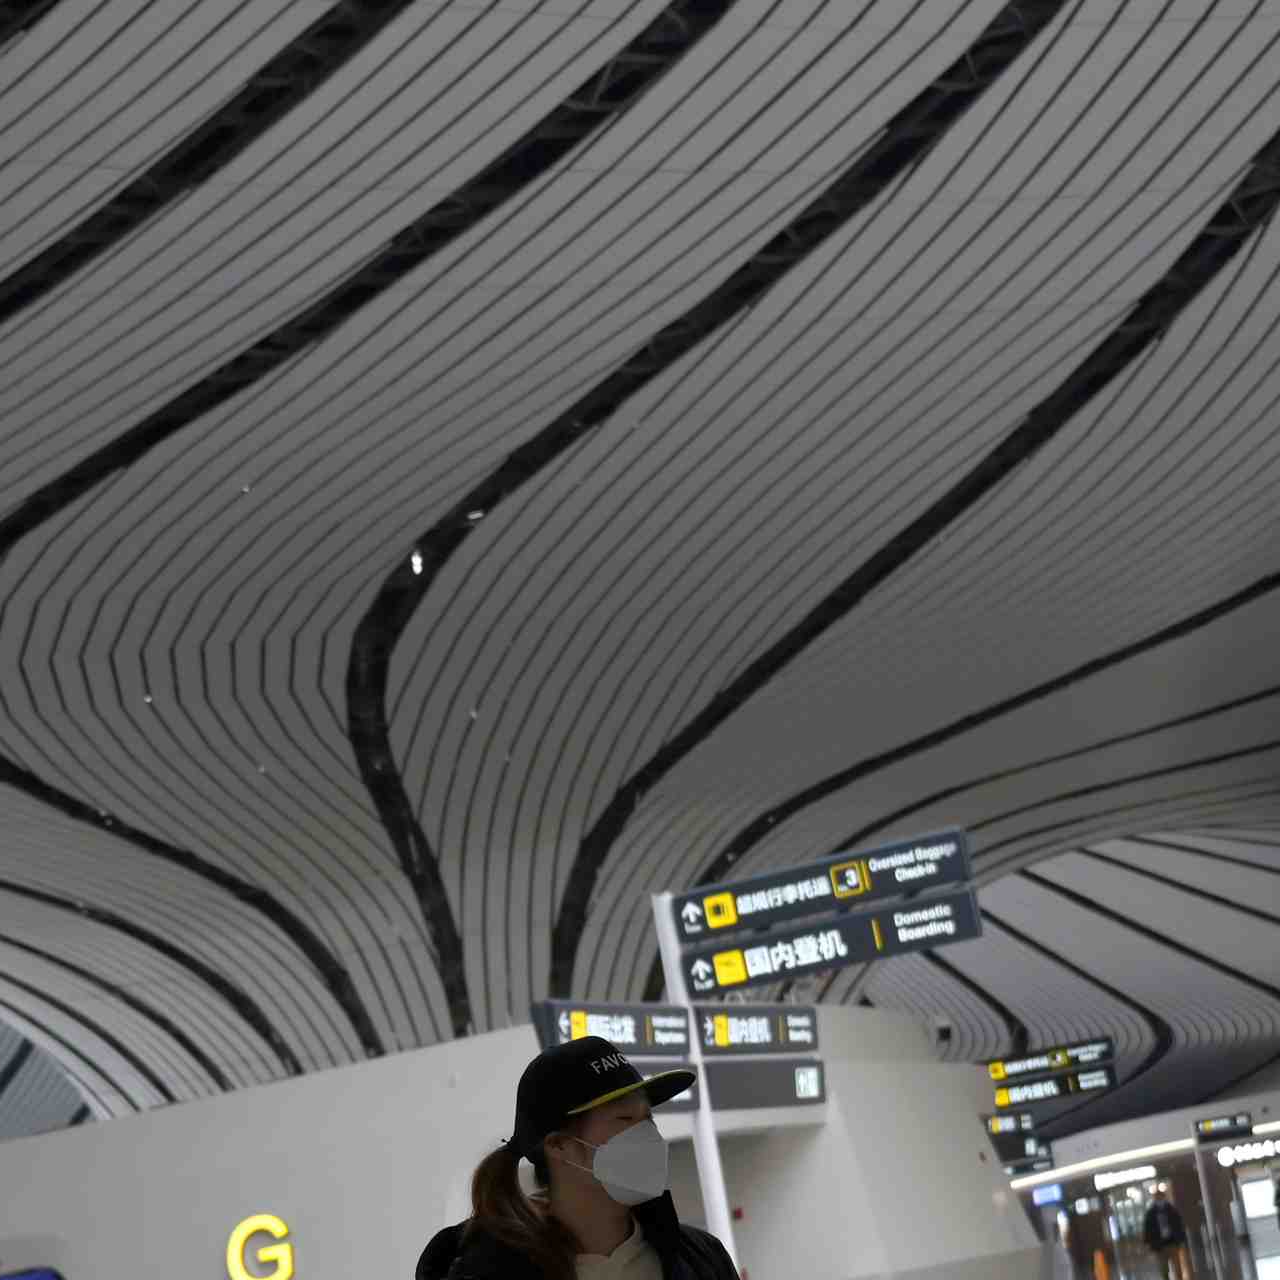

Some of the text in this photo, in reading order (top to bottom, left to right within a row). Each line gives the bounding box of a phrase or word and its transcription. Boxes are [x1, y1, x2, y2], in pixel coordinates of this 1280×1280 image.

[893, 904, 952, 927] Domestic
[897, 919, 956, 943] Boarding
[744, 930, 848, 978] 国内登机
